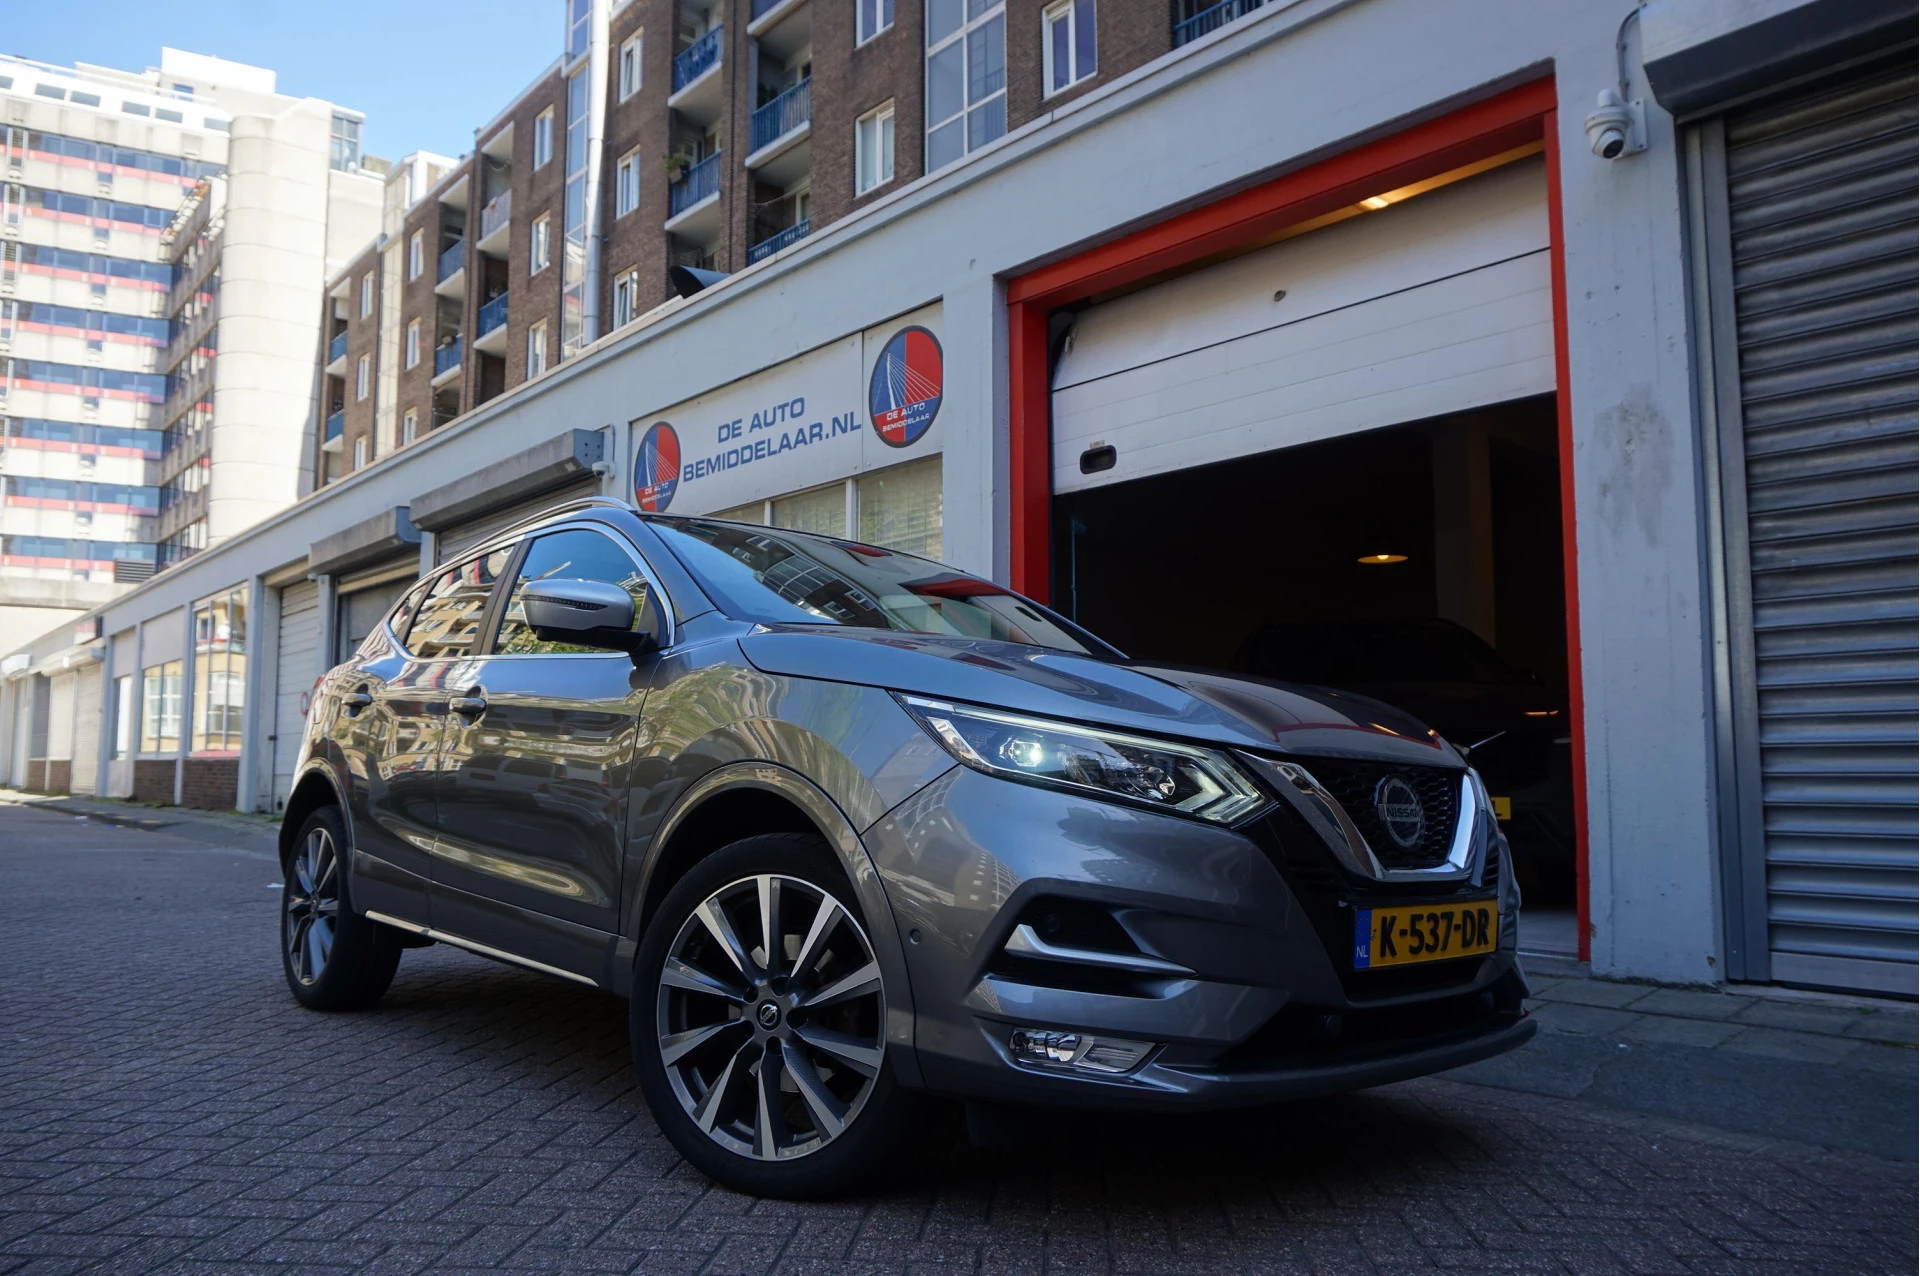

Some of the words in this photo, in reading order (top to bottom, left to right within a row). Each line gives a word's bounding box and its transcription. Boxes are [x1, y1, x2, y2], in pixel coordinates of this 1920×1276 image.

[718, 419, 742, 443] DE
[749, 397, 805, 433] AUTO
[886, 410, 898, 421] DE
[901, 402, 926, 417] AUTO
[882, 413, 930, 432] BEMIDDELAAR
[683, 411, 862, 483] BEMIDDELAAR.NL
[654, 482, 669, 492] AUTO
[1386, 807, 1420, 817] NISSAN
[1380, 908, 1489, 958] K-537-DR
[1356, 945, 1368, 958] NL
